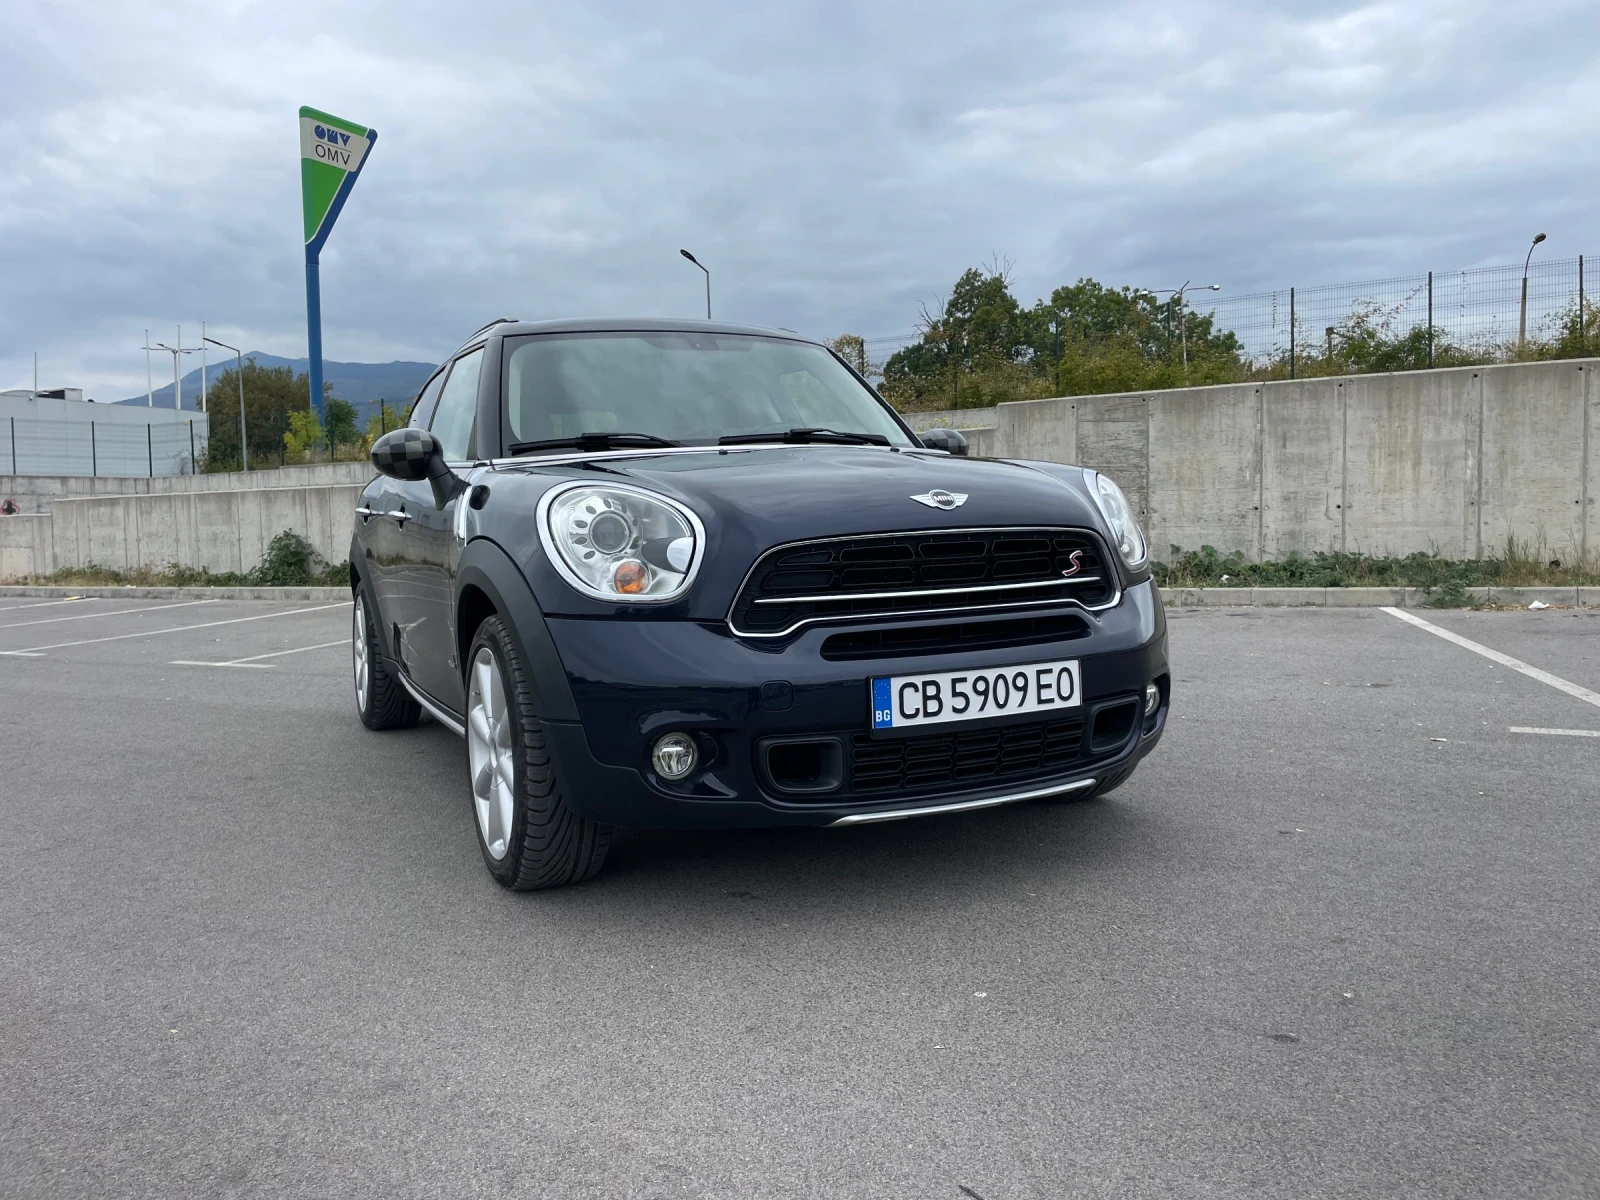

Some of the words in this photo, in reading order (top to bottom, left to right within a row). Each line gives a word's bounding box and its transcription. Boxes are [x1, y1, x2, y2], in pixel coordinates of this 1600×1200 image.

[315, 144, 350, 165] OMV
[1061, 549, 1083, 577] S
[875, 710, 891, 722] BG
